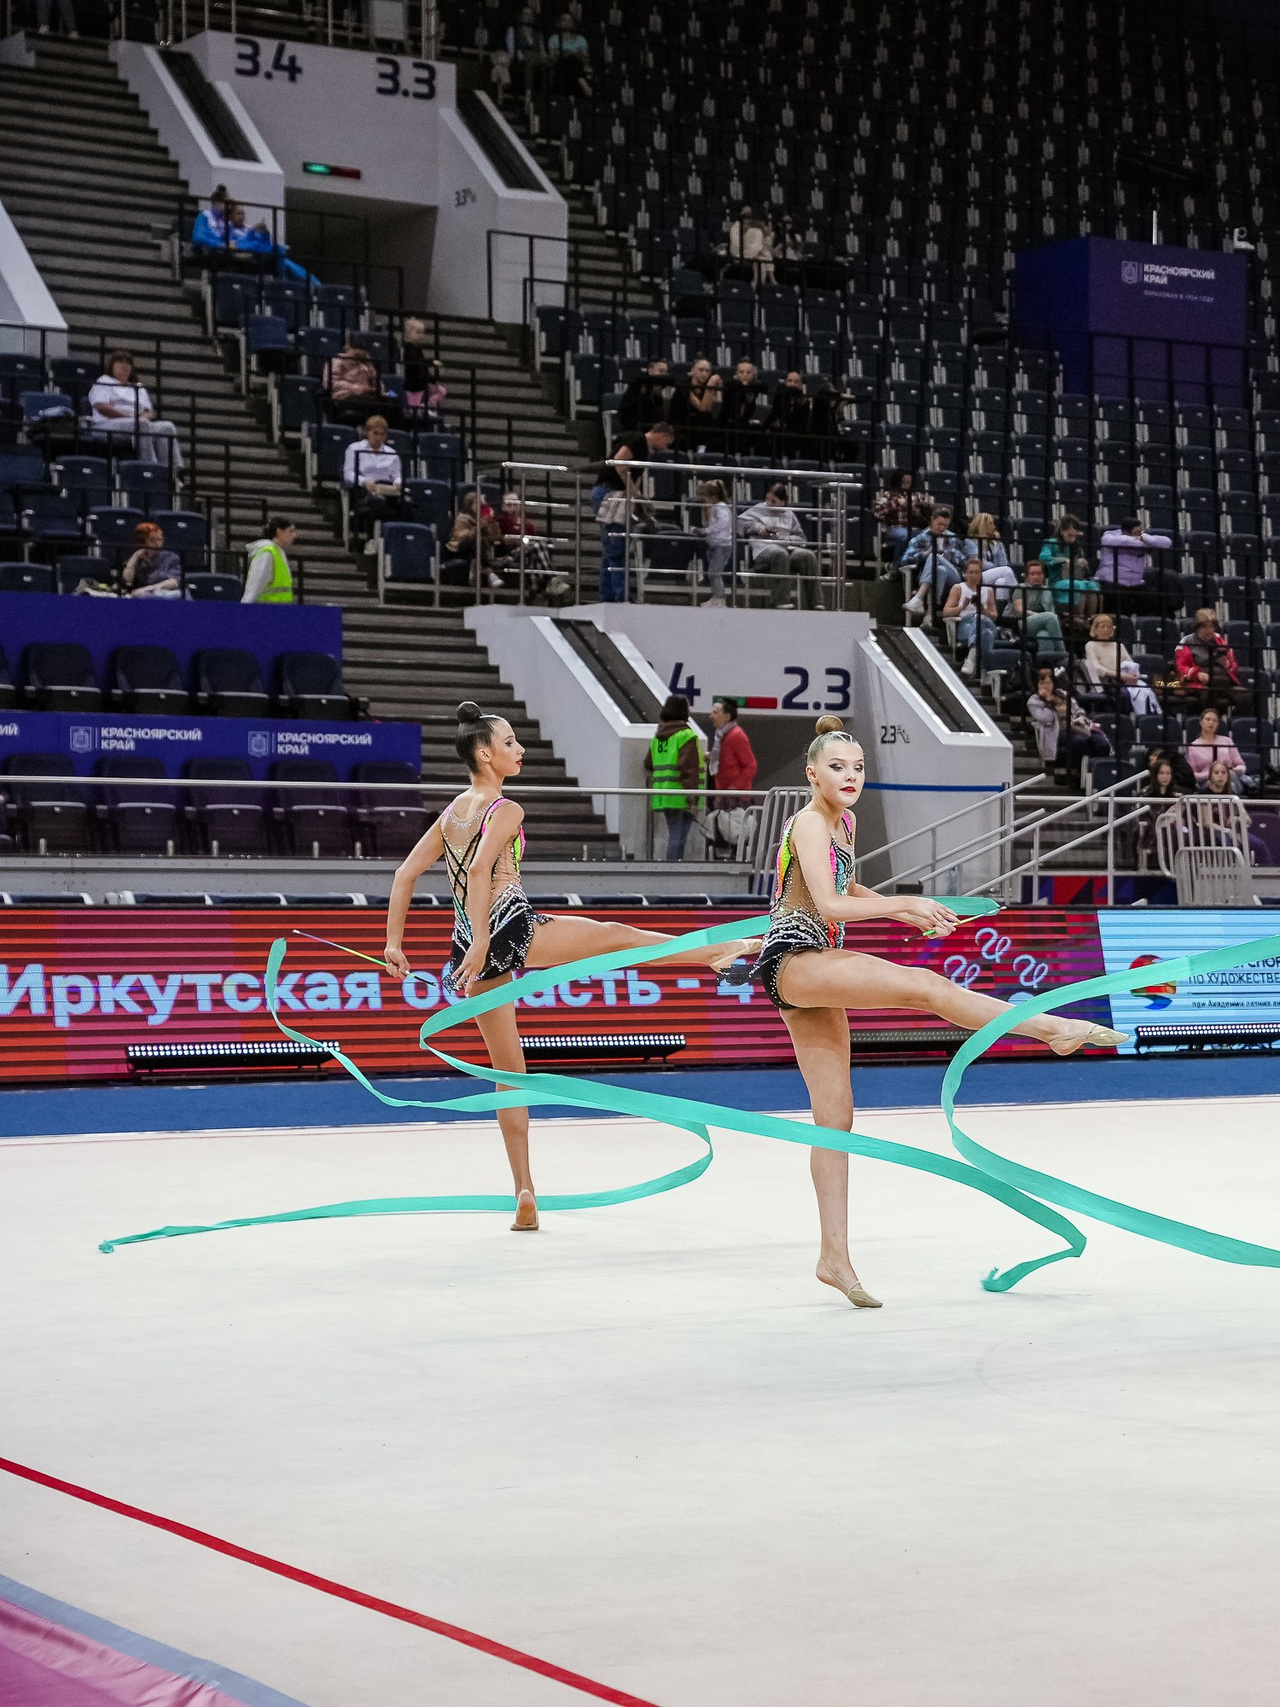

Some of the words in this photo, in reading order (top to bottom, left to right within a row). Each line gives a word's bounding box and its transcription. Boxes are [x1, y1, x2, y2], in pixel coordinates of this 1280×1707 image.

[234, 37, 302, 83] 3.4
[375, 56, 436, 100] 3.3
[1144, 264, 1215, 279] КРАСНОЯРСКИЙ
[1144, 274, 1167, 284] КРАЙ
[782, 666, 851, 711] 2.3
[101, 727, 202, 741] КРАСНОЯРСКИЙ
[277, 732, 372, 746] КРАСНОЯРСКИЙ
[101, 739, 135, 751] КРАЙ
[277, 741, 310, 755] КРАЙ
[0, 963, 382, 1028] Иркутская
